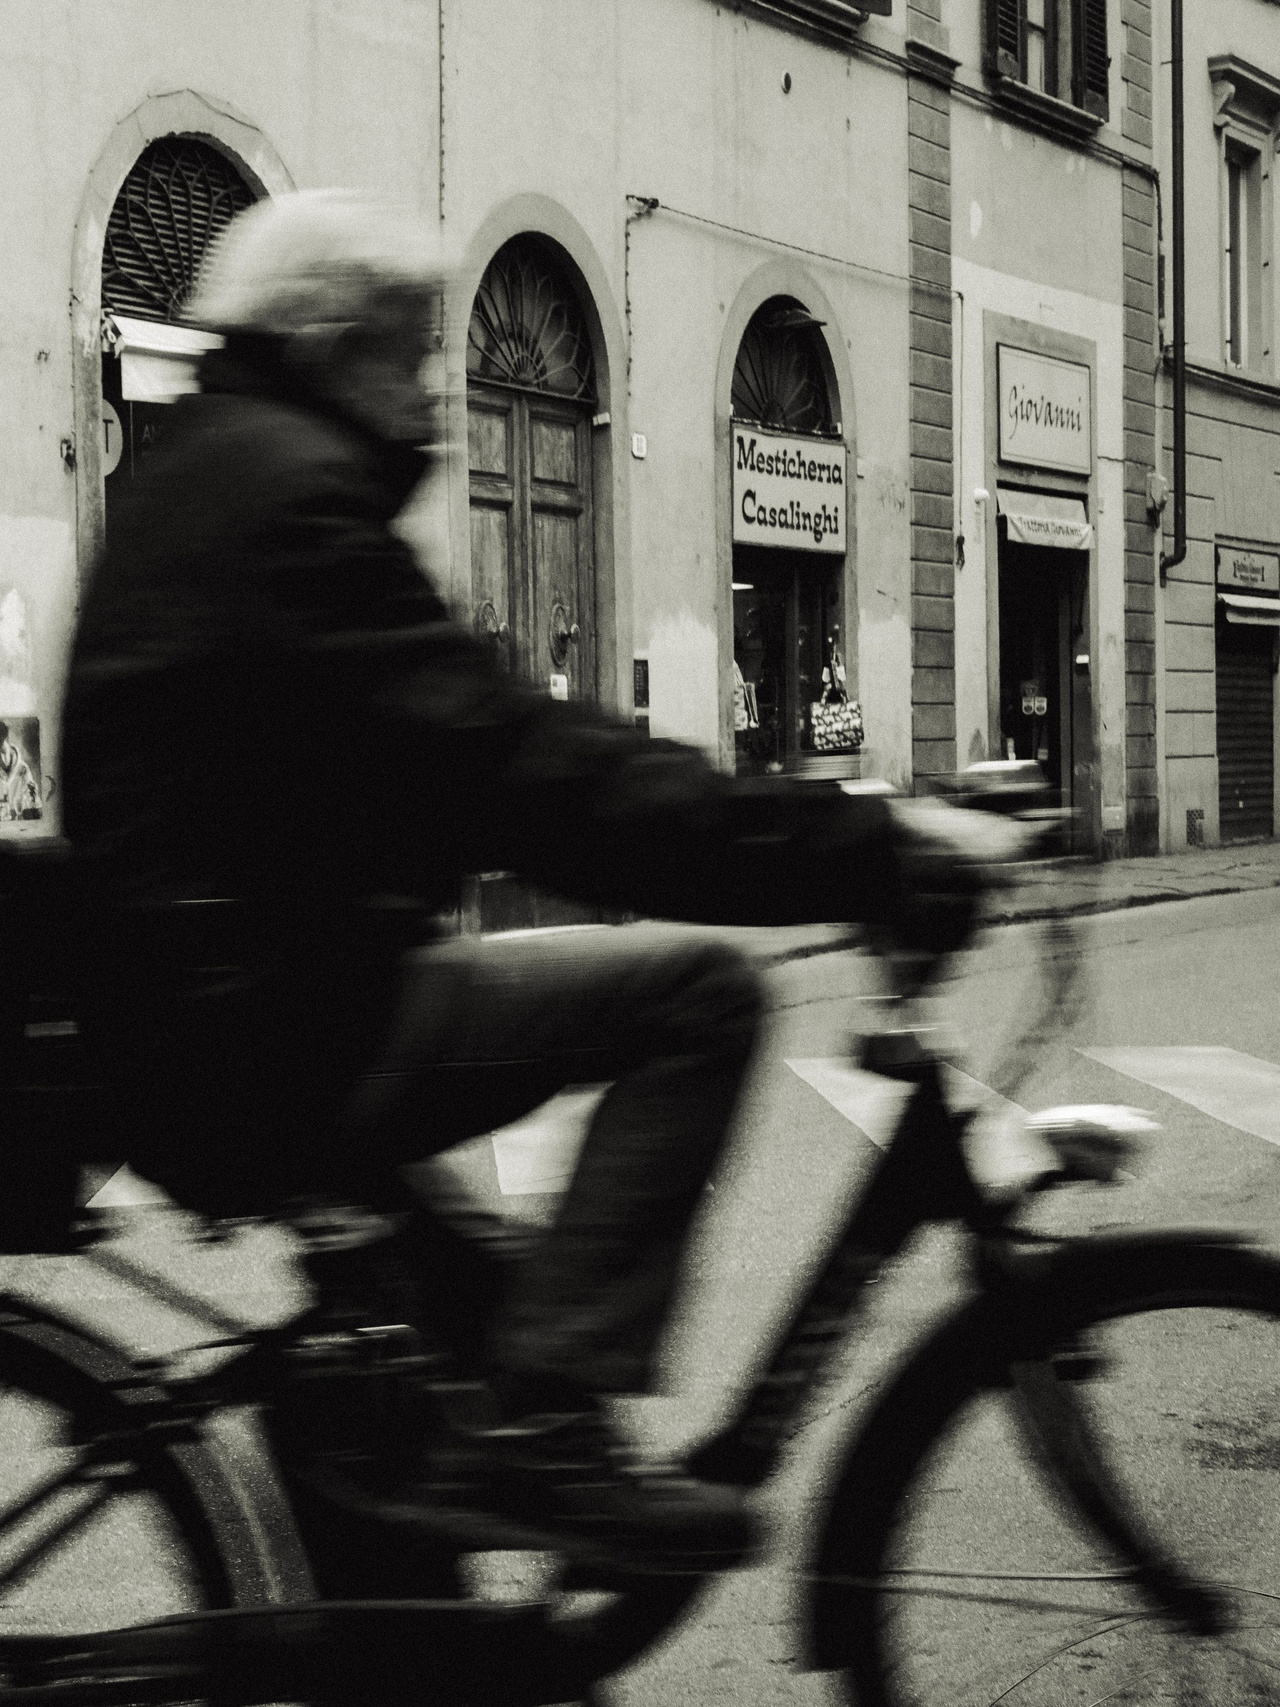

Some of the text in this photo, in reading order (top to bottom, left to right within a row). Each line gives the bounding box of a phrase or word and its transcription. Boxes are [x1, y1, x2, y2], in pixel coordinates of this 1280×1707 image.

[1009, 385, 1081, 439] Giovanni
[736, 435, 843, 485] Mesticheria
[741, 489, 839, 543] Casalinghi
